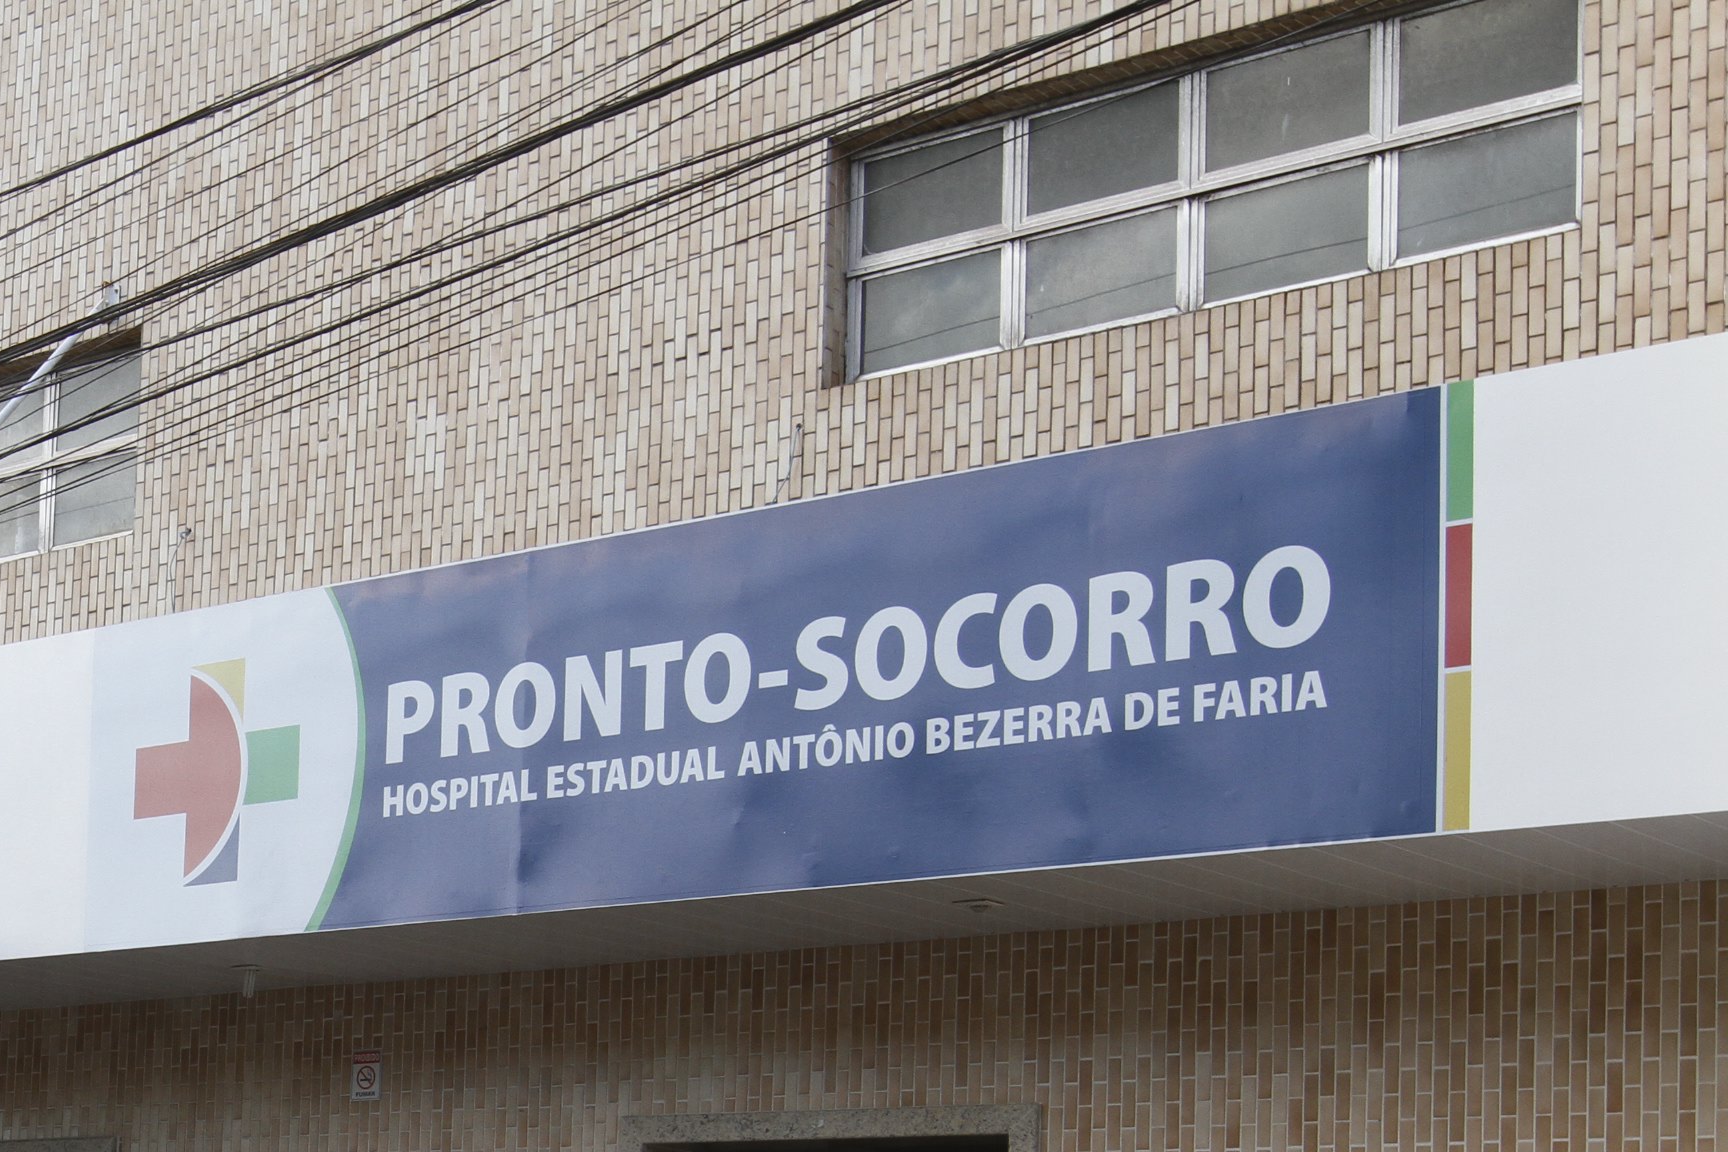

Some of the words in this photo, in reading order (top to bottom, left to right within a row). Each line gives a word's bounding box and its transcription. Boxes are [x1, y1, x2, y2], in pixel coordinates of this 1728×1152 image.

[382, 768, 538, 818] HOSPITAL
[546, 745, 726, 800] ESTADUAL
[737, 721, 915, 777] ANTÔNIO
[926, 696, 1112, 755] BEZERRA
[1124, 687, 1180, 731] DE
[1193, 670, 1328, 725] FARIA
[384, 545, 1332, 766] PRONTO-SOCORRO
